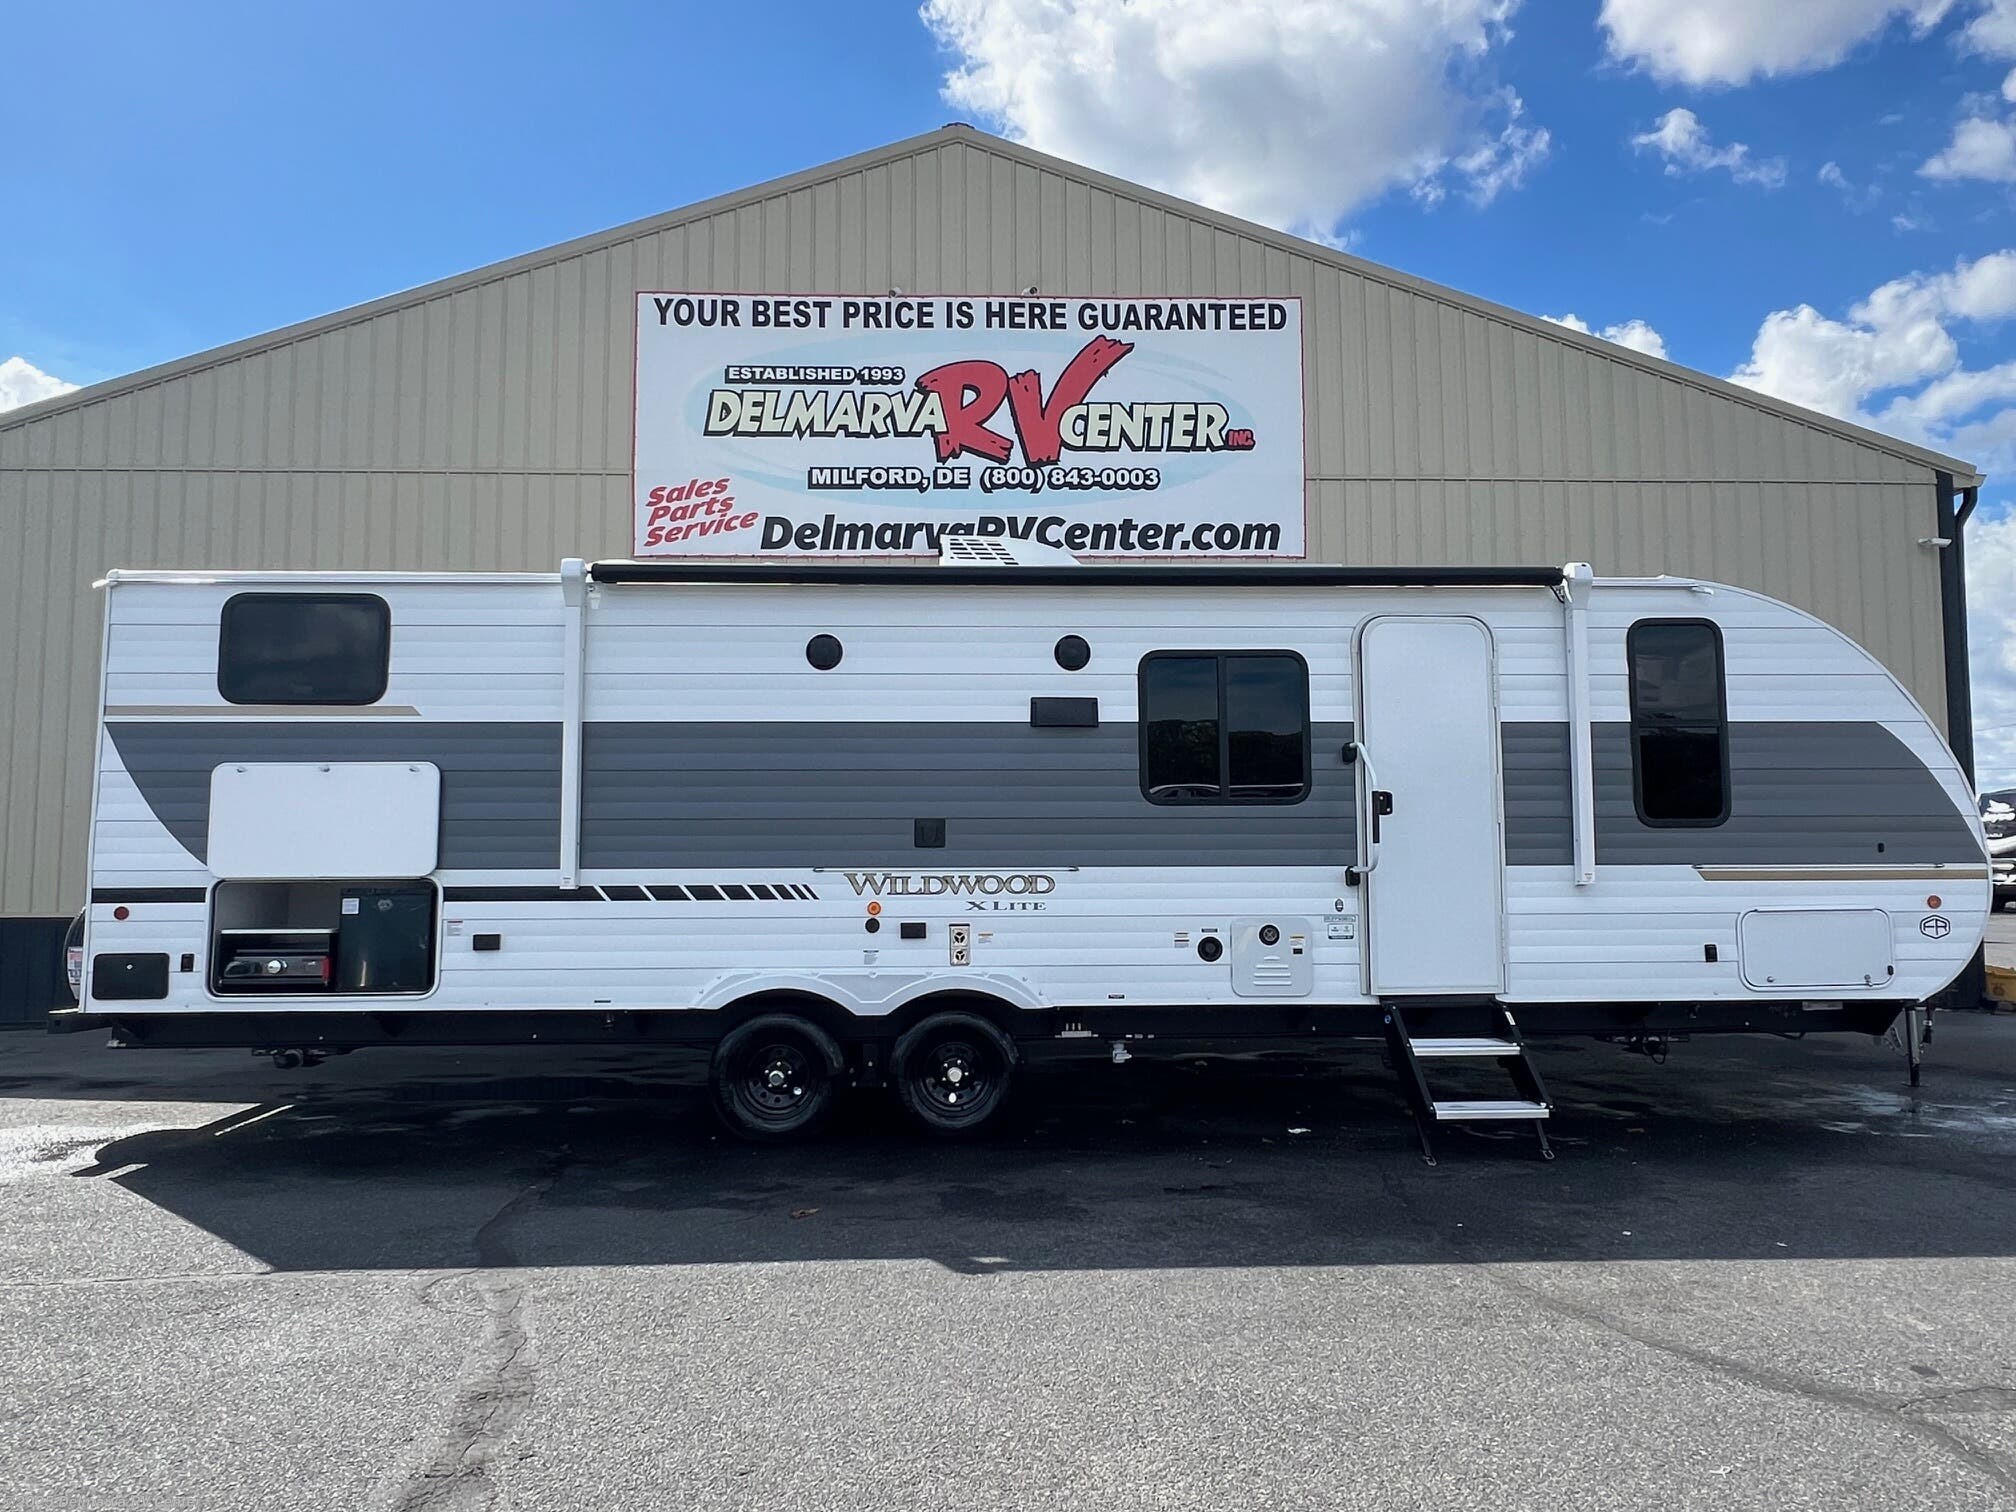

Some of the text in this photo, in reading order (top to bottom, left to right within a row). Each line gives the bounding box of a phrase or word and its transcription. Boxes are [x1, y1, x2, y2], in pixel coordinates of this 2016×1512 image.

[653, 298, 1287, 331] YOUR BEST PRICE IS HERE GUARANTEED
[726, 366, 905, 383] ESTABLISHED 1993
[704, 389, 949, 438] DELMARVA
[915, 335, 1135, 465] RV
[1058, 402, 1228, 450] CENTER
[645, 477, 731, 507] Sales
[808, 467, 1160, 492] MILFORD, DE (800) 843-0003
[647, 494, 736, 527] Parts
[843, 872, 1056, 896] WILDWOOD
[965, 900, 1047, 911] X LITE
